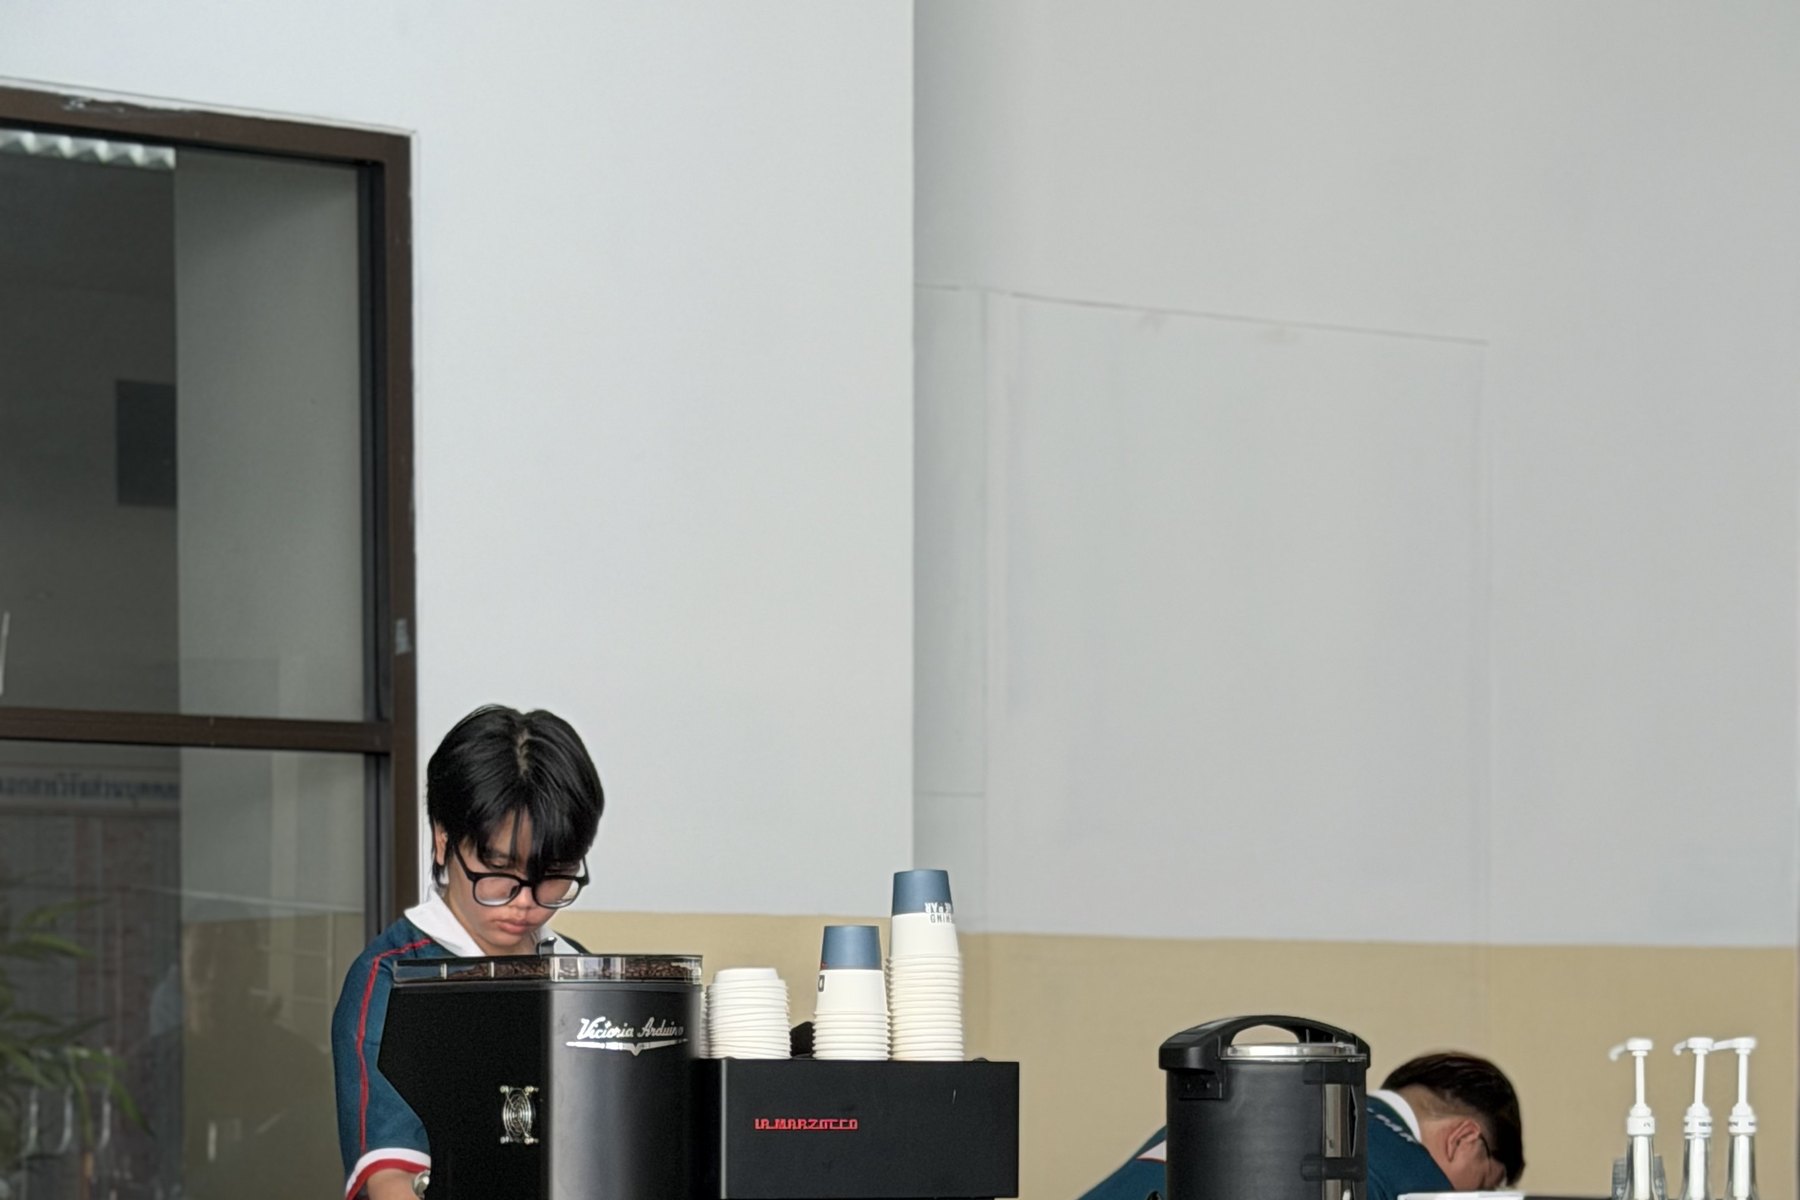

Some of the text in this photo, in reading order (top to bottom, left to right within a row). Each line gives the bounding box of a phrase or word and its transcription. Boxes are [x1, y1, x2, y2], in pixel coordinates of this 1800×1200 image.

[576, 1016, 684, 1040] Victoria Arduino
[774, 1118, 858, 1130] MARZOCCO
